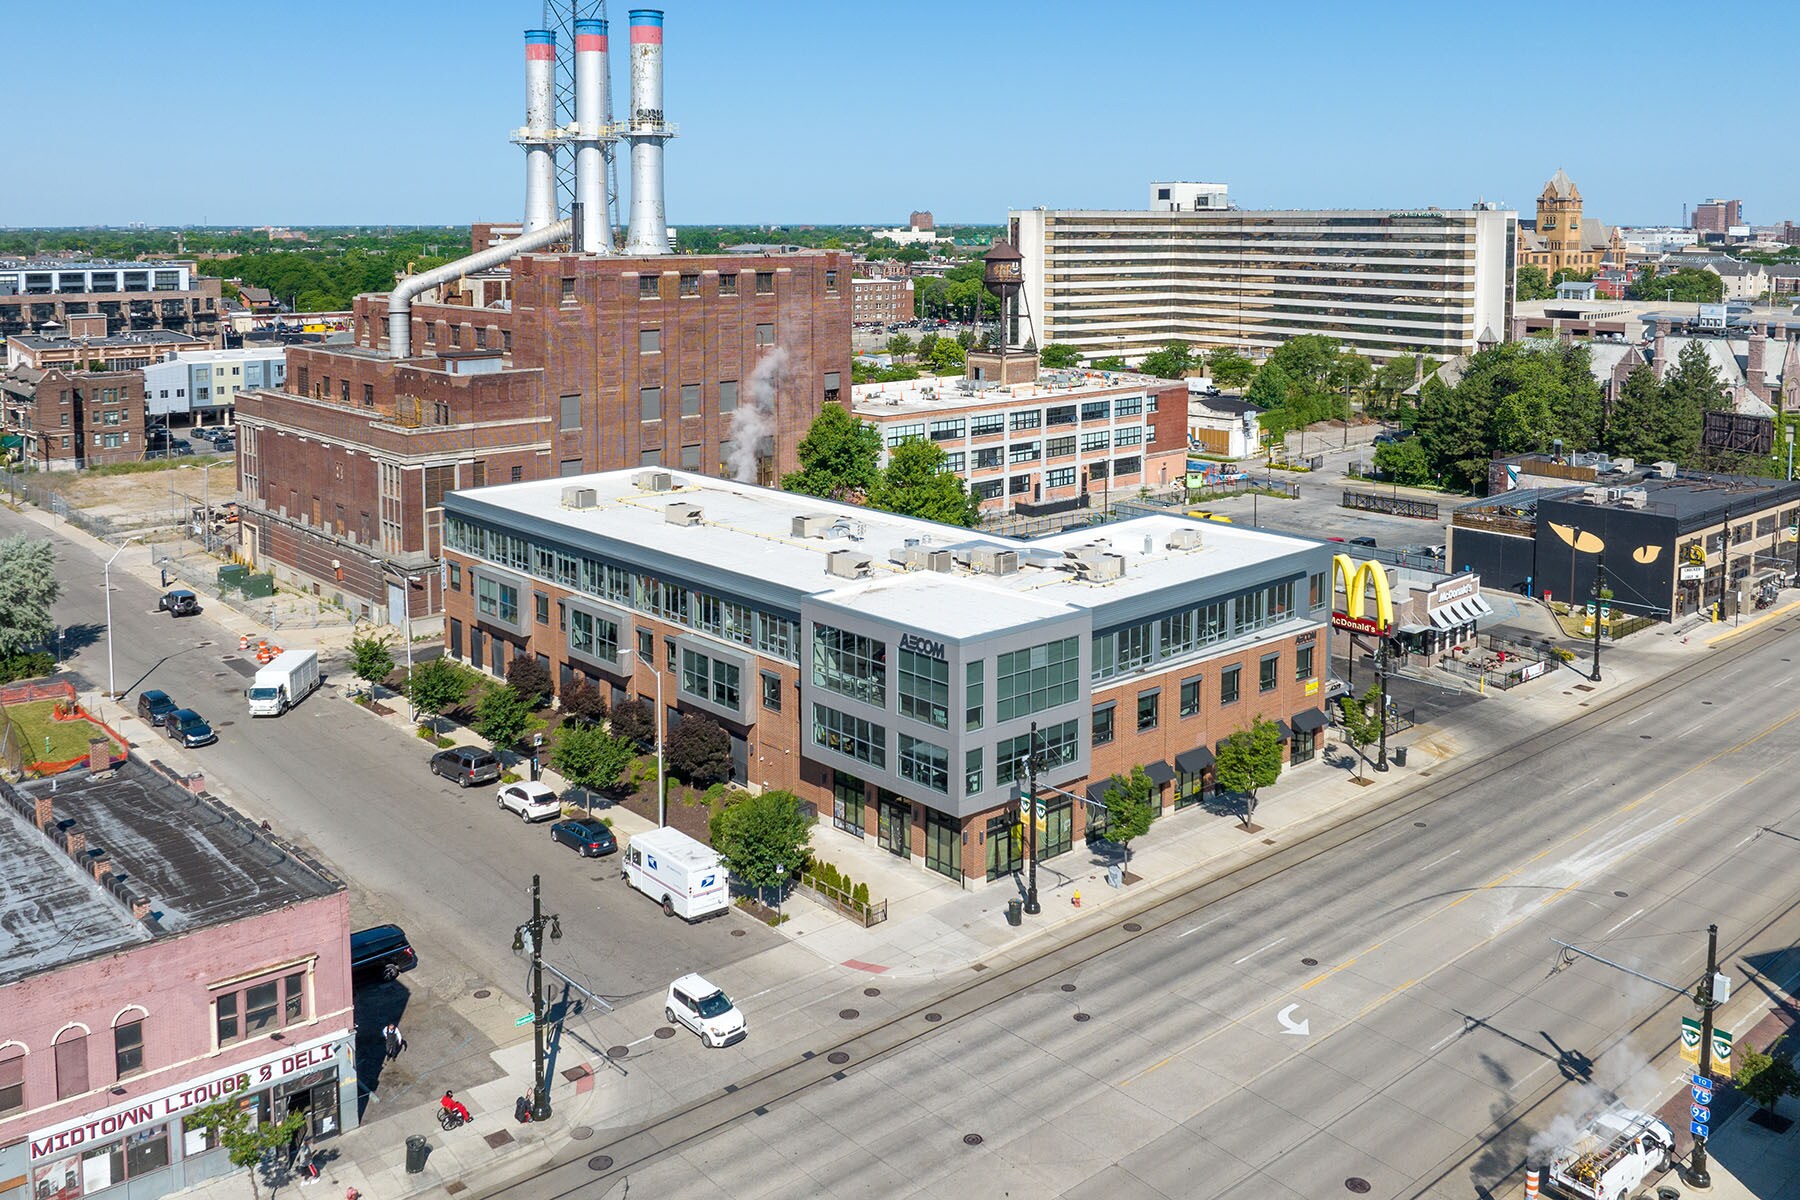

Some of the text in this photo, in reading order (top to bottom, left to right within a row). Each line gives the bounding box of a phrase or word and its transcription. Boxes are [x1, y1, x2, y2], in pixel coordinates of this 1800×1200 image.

[1438, 583, 1473, 603] McDonald's
[900, 633, 945, 660] AECOM
[31, 1104, 153, 1159] MIDTOWN
[282, 1043, 333, 1074] DELI
[1694, 1089, 1709, 1102] 75
[1692, 1107, 1707, 1121] 94
